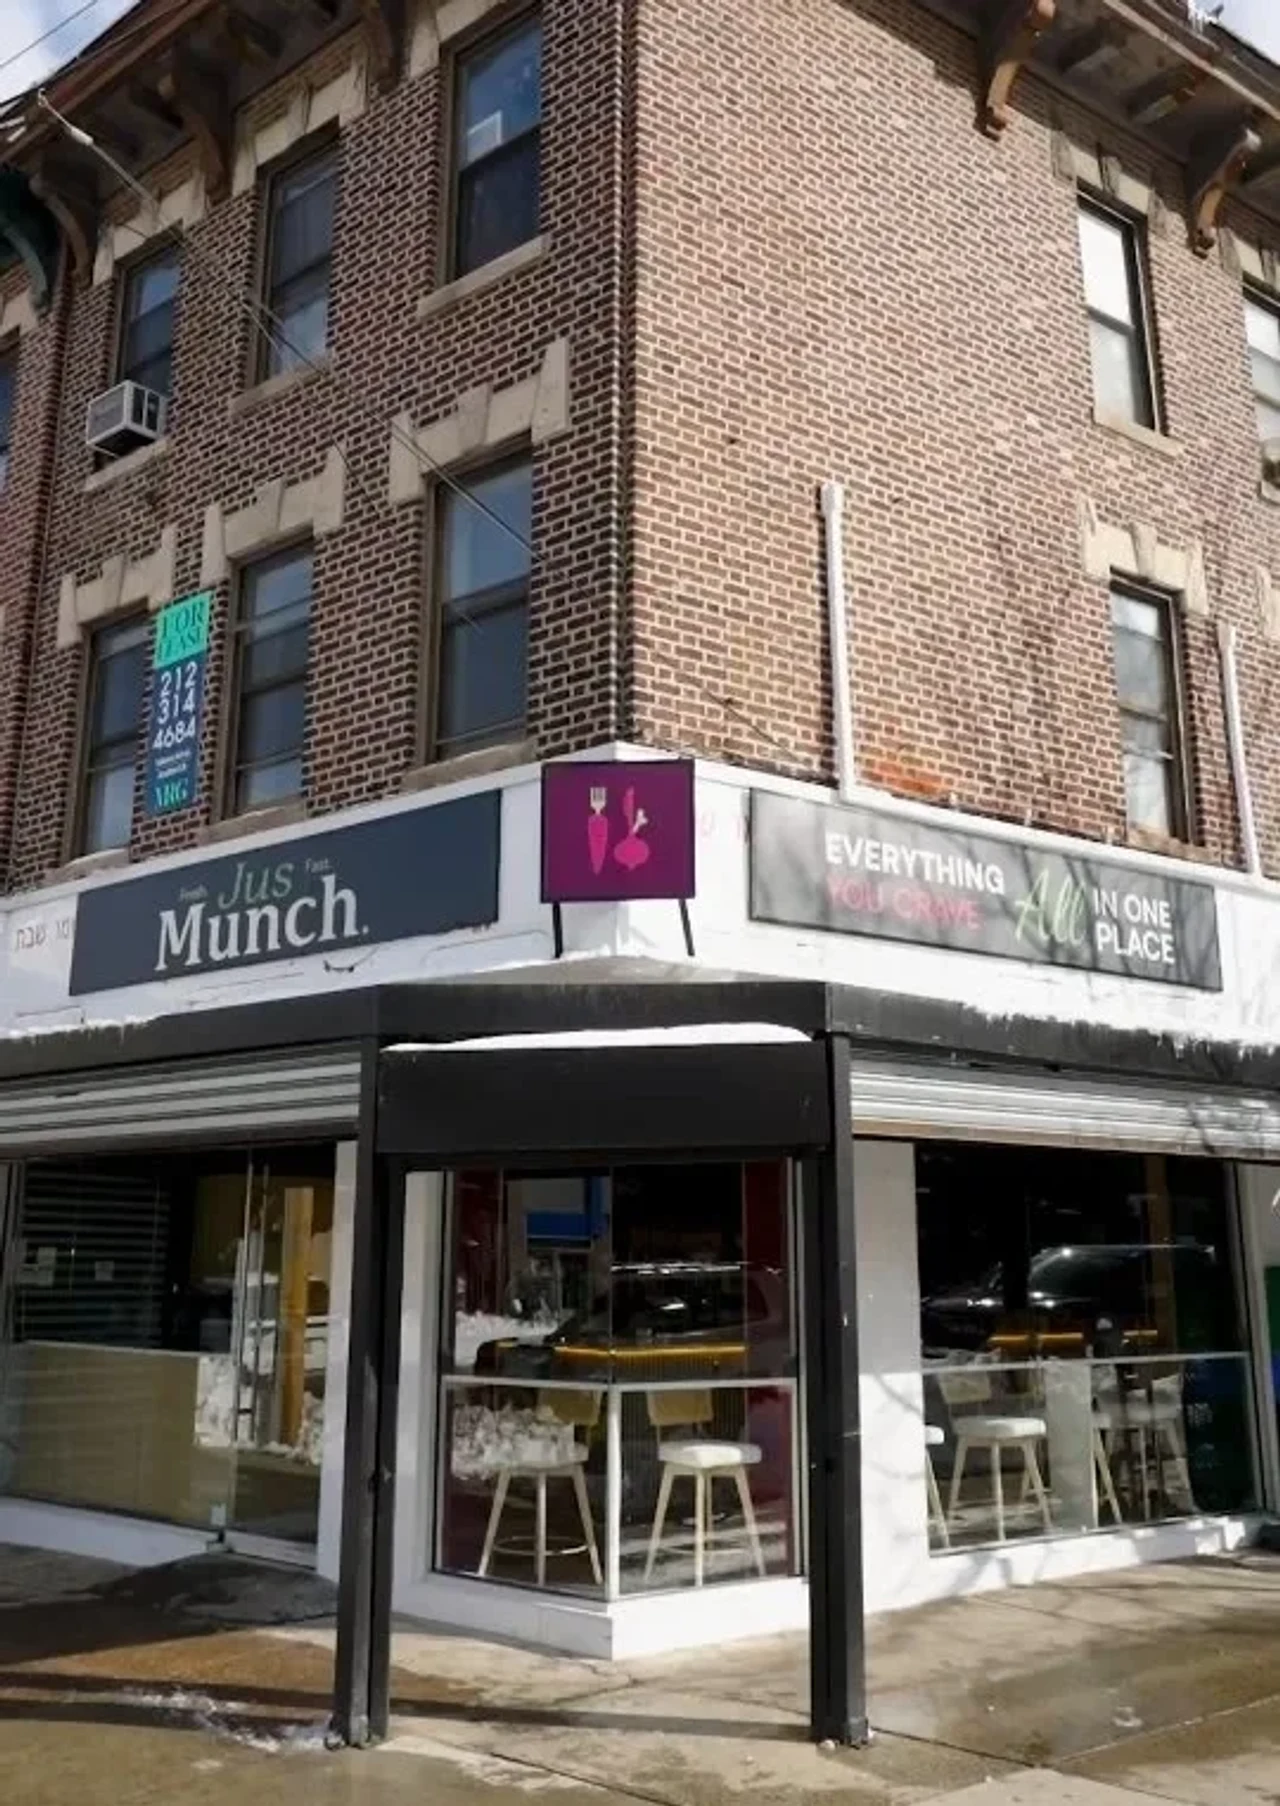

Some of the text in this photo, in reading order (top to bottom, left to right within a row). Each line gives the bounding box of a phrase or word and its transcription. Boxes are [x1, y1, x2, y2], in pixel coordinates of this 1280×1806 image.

[160, 660, 197, 697] 212
[157, 688, 196, 724] 314
[152, 716, 196, 749] 4684
[217, 862, 295, 909] Jus
[825, 831, 1005, 895] EVERYTHING
[154, 873, 370, 971] Munch.
[827, 873, 984, 931] YOU CRAVE
[1015, 868, 1087, 945] All
[1092, 887, 1172, 929] IN ONE
[1095, 921, 1176, 965] PLACE
